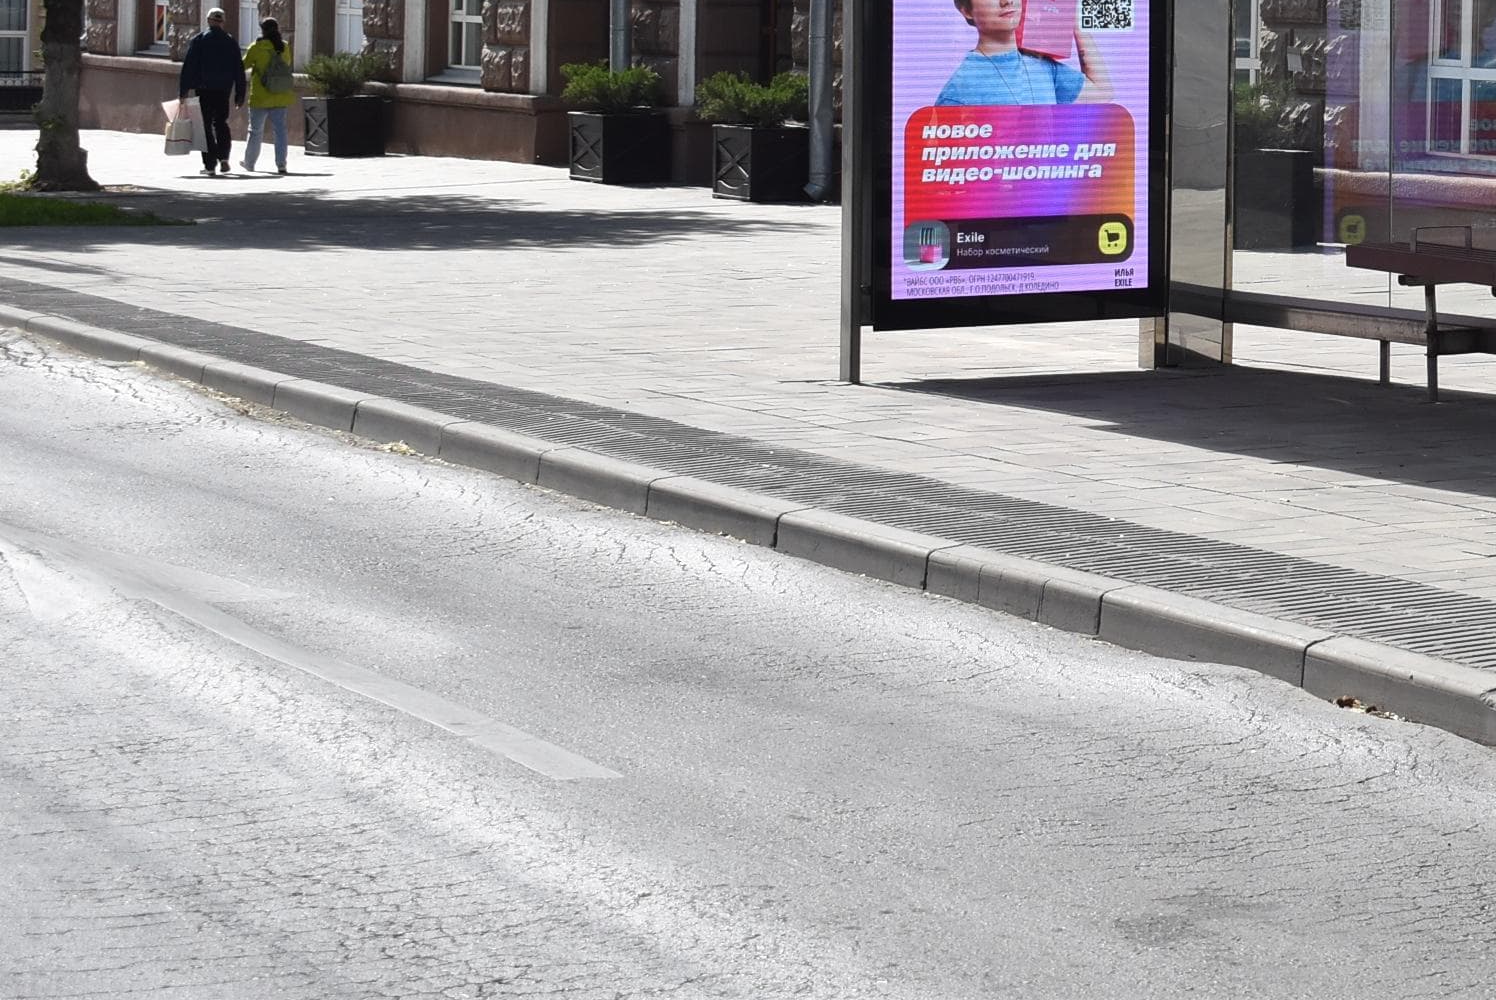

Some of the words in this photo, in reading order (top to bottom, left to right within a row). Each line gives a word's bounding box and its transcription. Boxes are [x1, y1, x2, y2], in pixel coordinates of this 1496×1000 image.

[922, 124, 993, 139] новое
[921, 145, 1069, 165] приложение
[1073, 143, 1117, 160] для
[921, 164, 1102, 184] видео-шопинга
[956, 231, 985, 243] Exile
[956, 248, 984, 257] Набор
[985, 244, 1050, 256] косметический
[1114, 268, 1135, 277] ИЛЬЯ
[1114, 278, 1133, 287] EXILE
